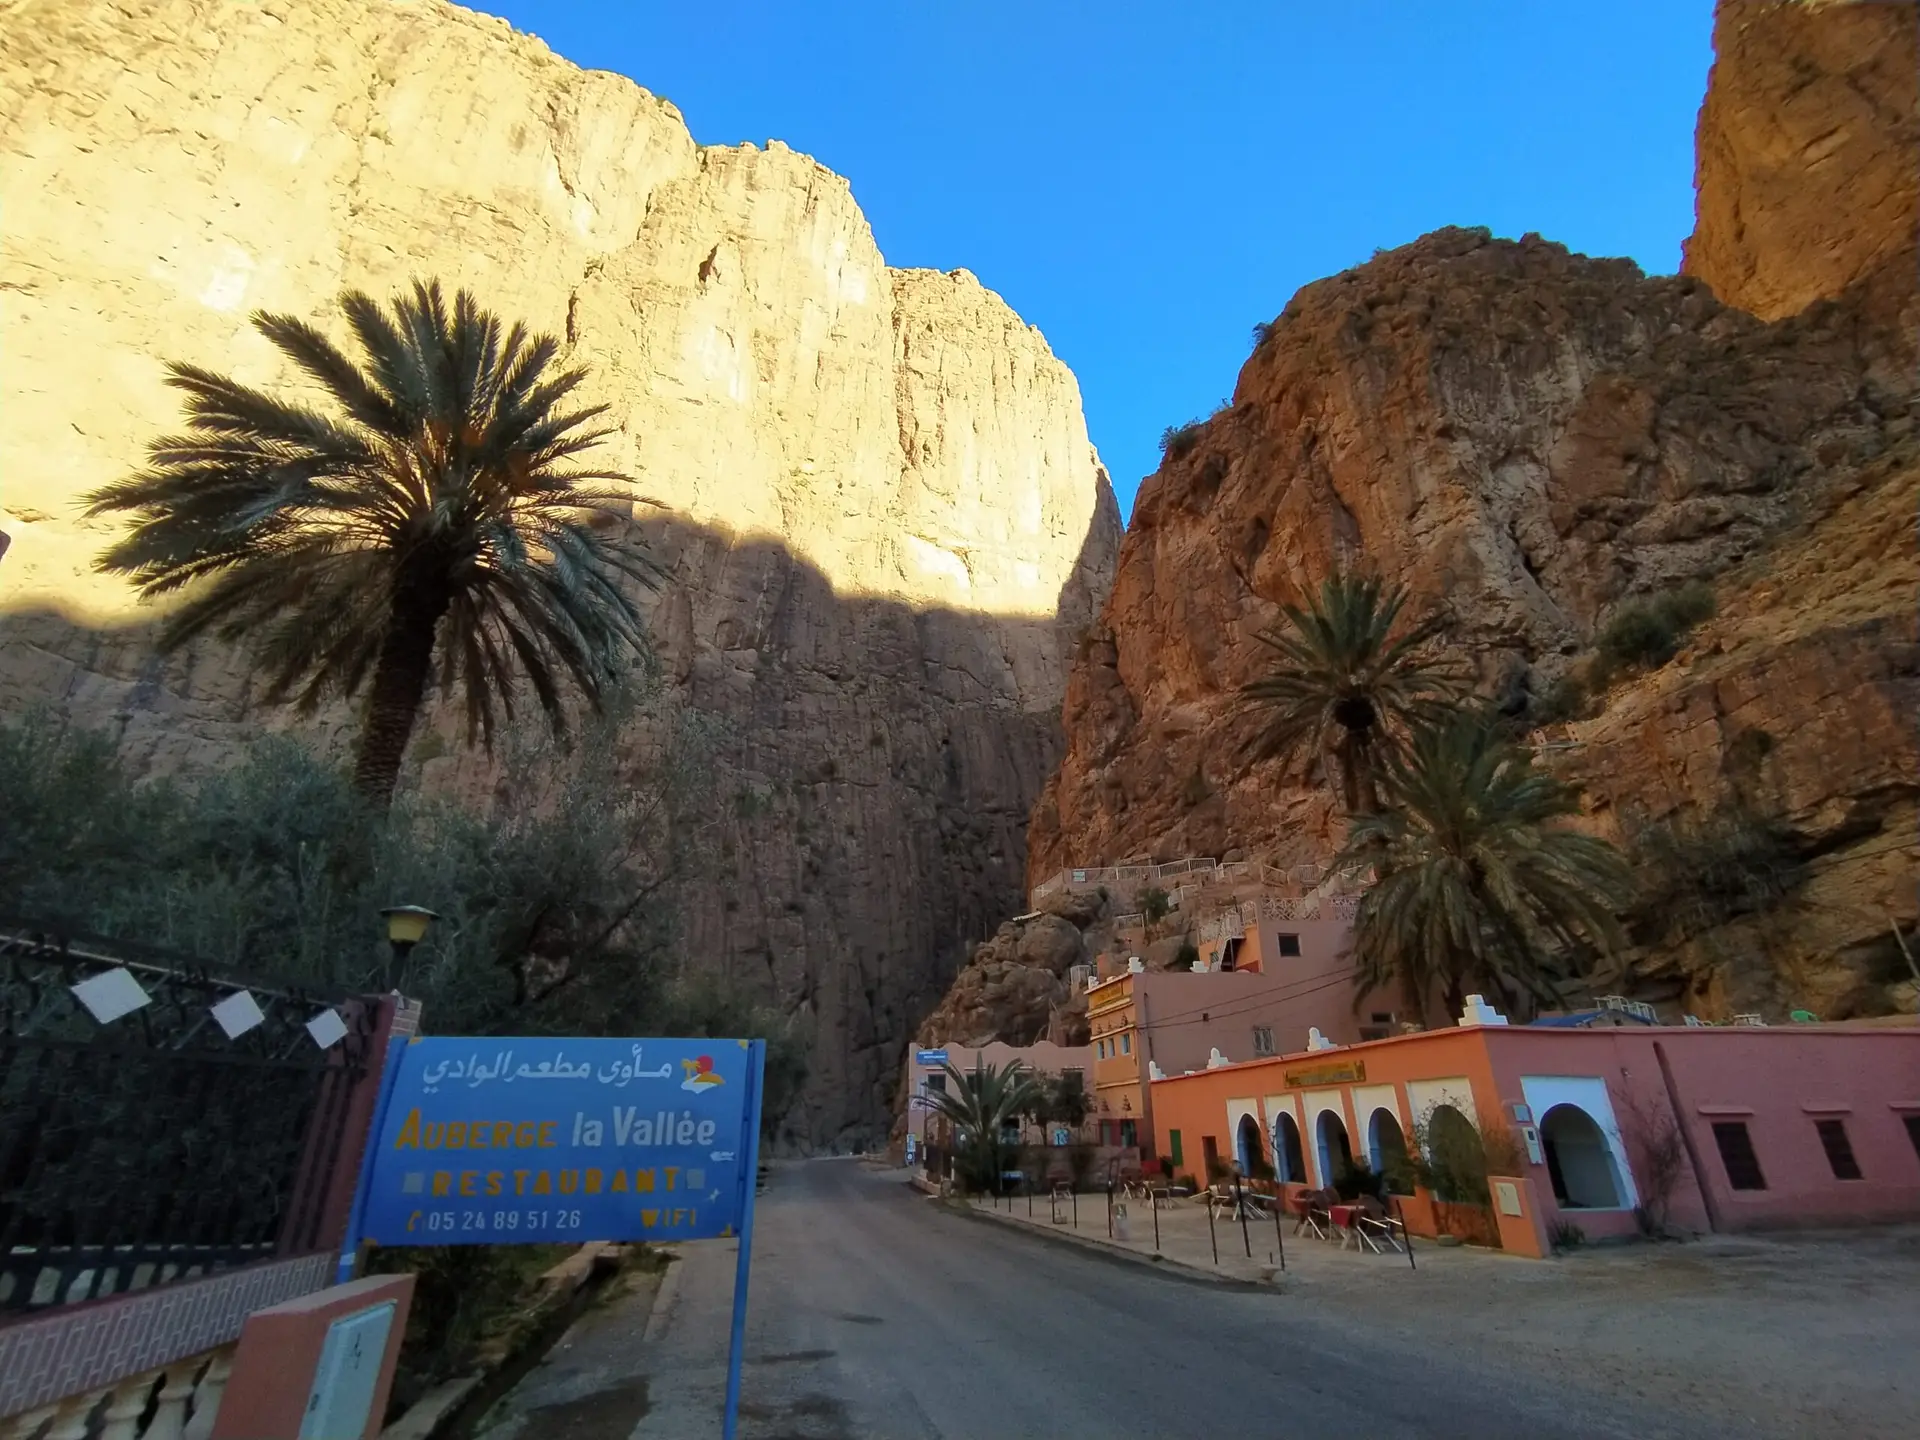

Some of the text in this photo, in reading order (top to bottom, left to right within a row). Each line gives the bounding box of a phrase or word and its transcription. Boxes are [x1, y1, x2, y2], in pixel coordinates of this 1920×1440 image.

[422, 1043, 673, 1094] مأوى مطعم الوادي
[571, 1111, 603, 1147] la
[432, 1166, 680, 1197] RESTAURANT
[428, 1209, 581, 1231] 05 24 89 51 26
[640, 1207, 697, 1228] WIFI
